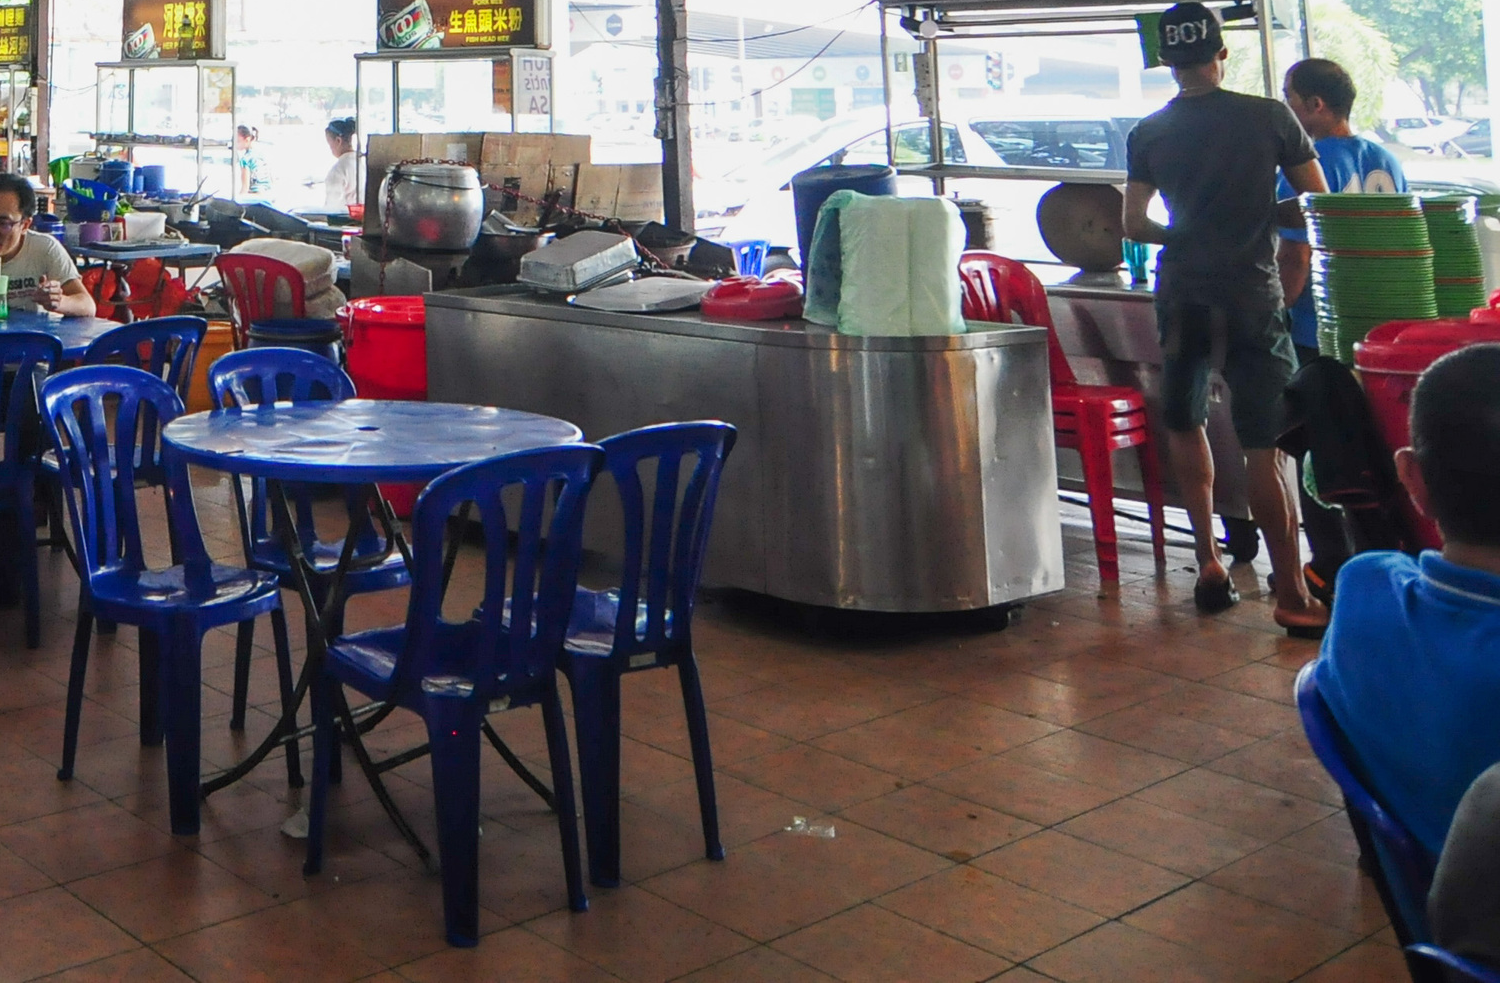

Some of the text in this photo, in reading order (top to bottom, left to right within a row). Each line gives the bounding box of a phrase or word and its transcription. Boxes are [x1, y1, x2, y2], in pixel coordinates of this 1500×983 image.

[390, 14, 414, 40] 100
[448, 7, 523, 34] 生魚頭米粉
[1165, 19, 1208, 45] BOY
[480, 35, 496, 43] HEAD
